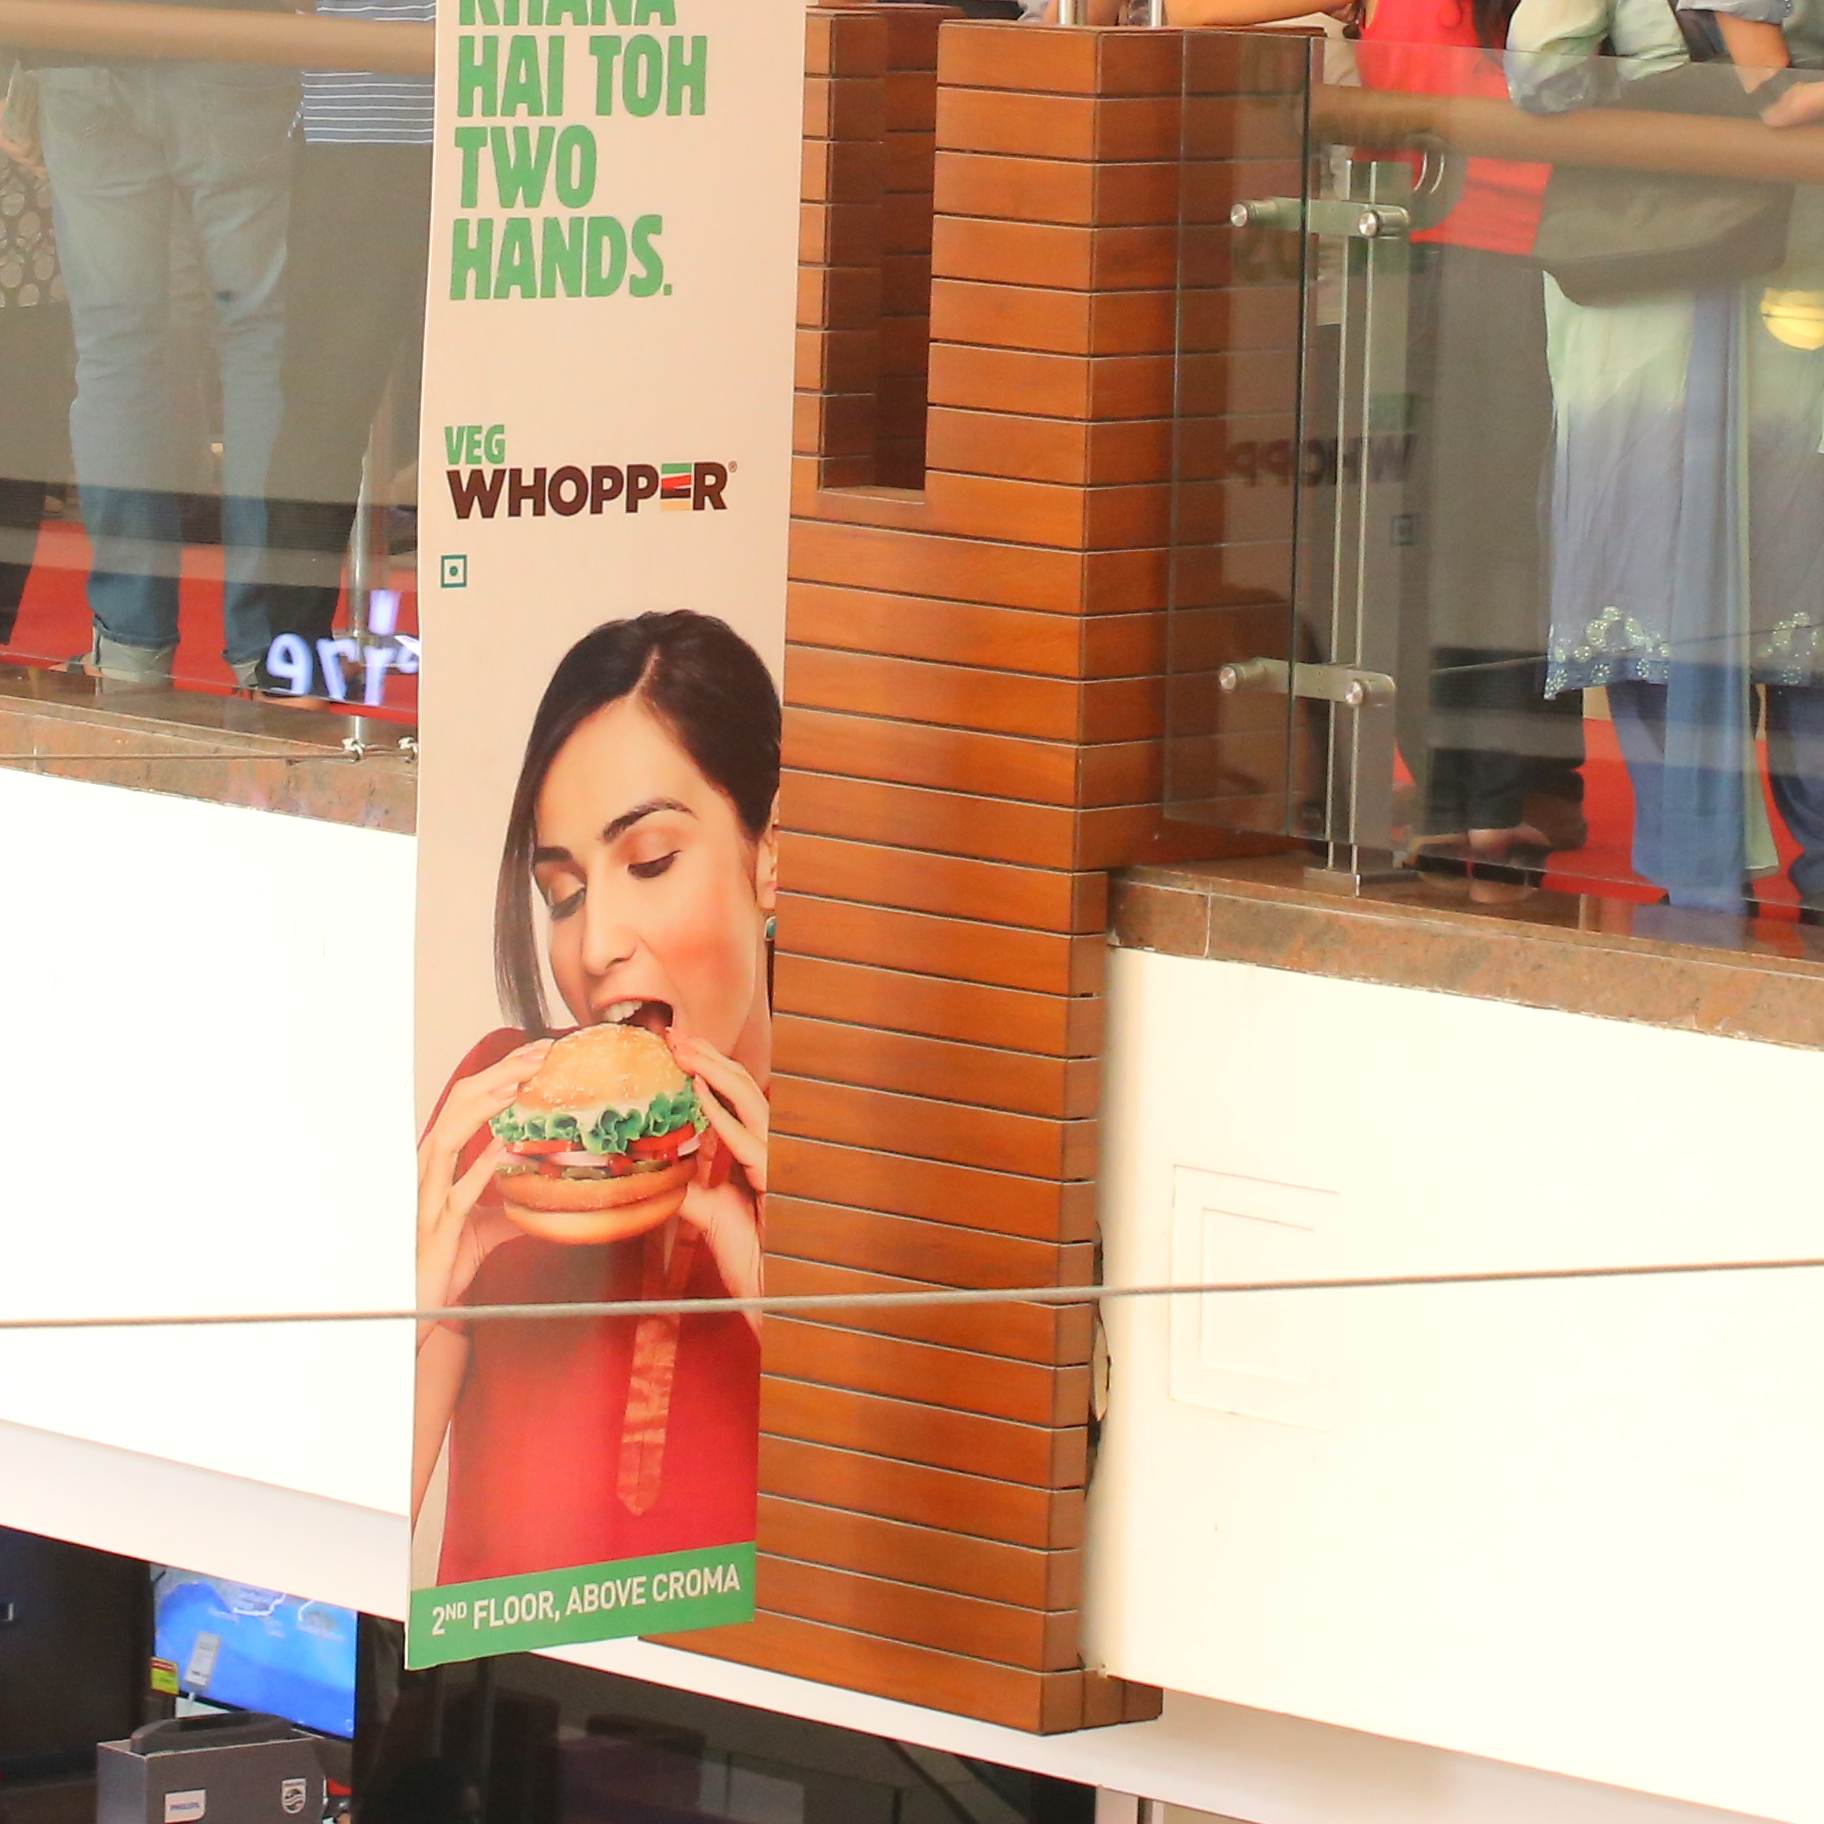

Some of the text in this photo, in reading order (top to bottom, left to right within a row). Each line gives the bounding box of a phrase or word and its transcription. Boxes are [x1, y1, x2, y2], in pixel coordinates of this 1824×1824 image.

[457, 35, 709, 118] HAI TOH
[454, 125, 598, 210] TWO
[449, 214, 674, 301] HANDS.
[444, 424, 506, 467] VEG
[432, 1563, 741, 1636] 2ND FLOOR, ABOVE CROMA
